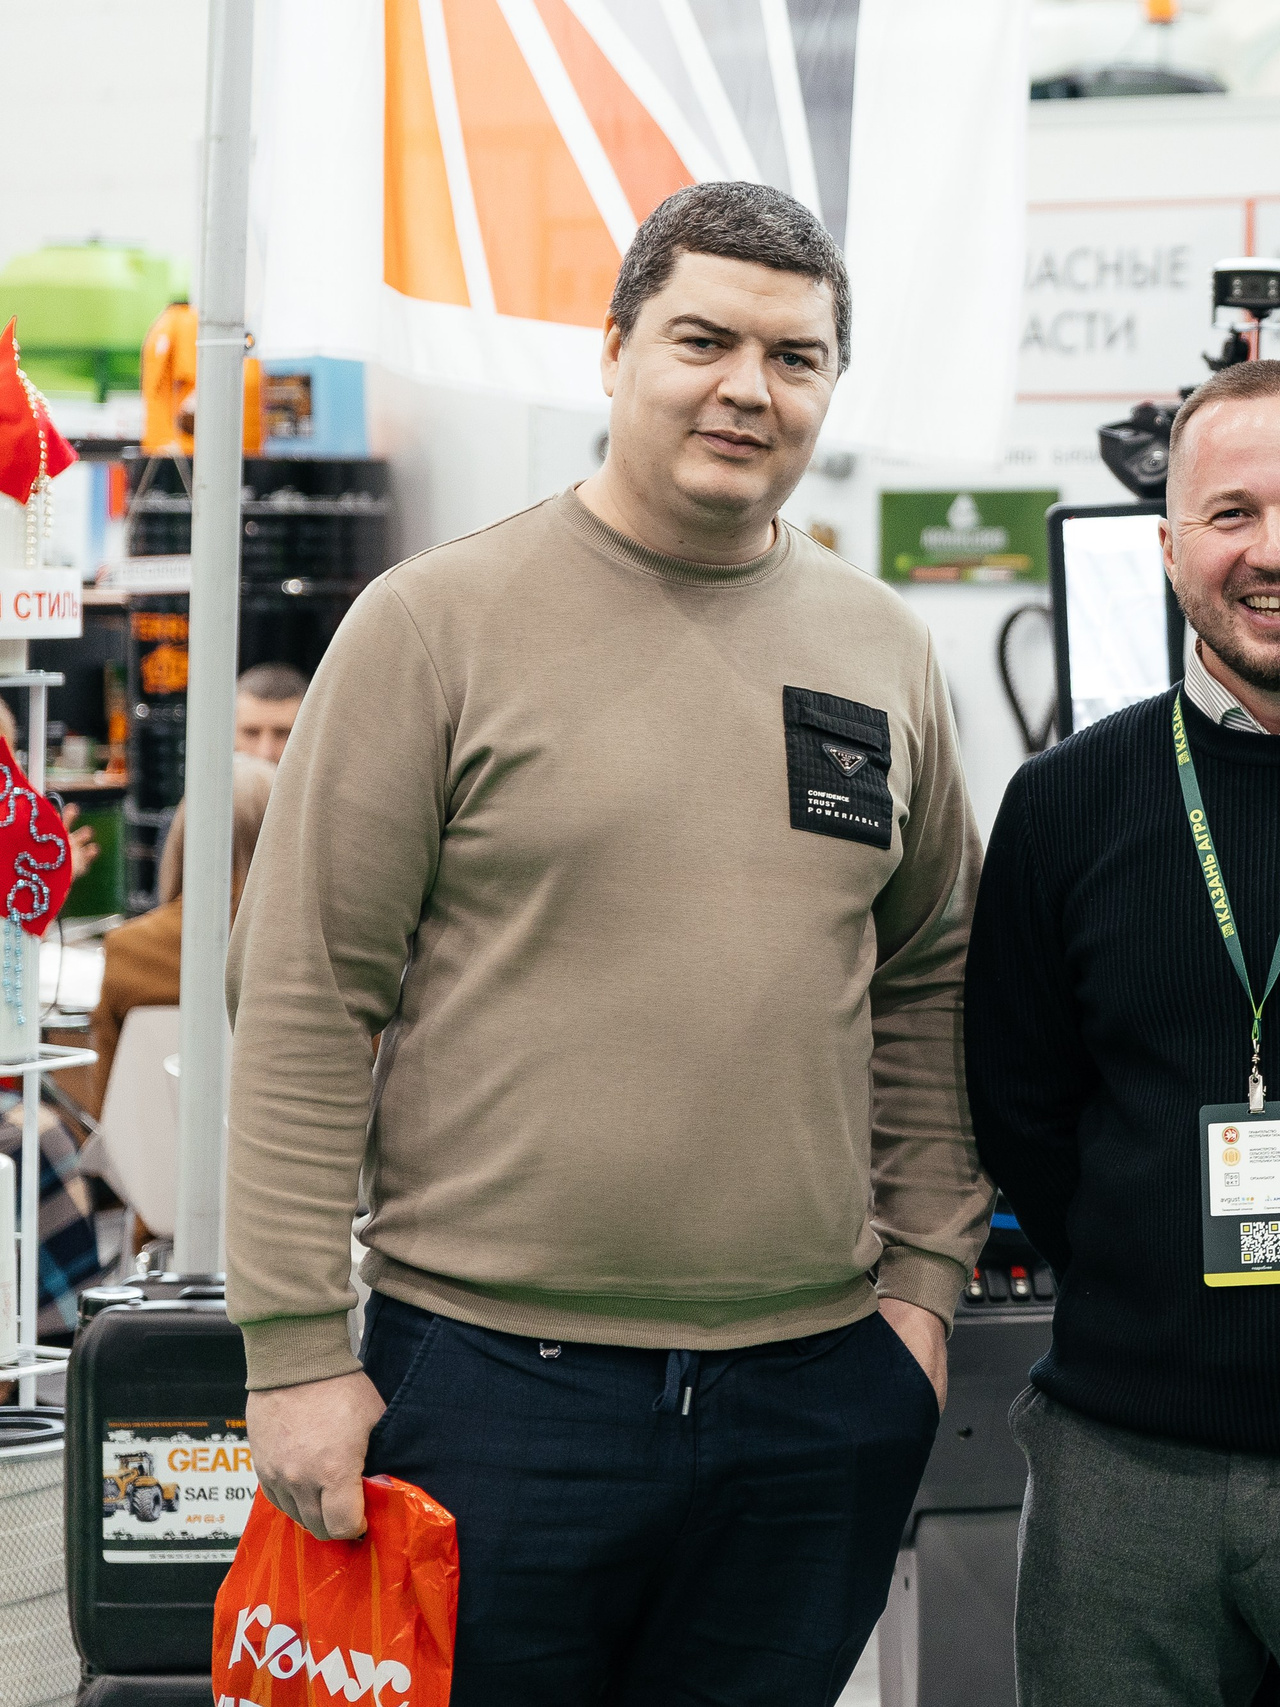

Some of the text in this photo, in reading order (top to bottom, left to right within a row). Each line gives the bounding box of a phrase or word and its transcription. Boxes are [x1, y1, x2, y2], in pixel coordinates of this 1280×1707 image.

[1019, 310, 1139, 354] АСТИ
[1172, 700, 1187, 753] КАЗА
[807, 789, 850, 803] CONFIDENCE
[807, 798, 836, 808] TRUST
[1188, 808, 1231, 925] КАЗАНЬ АГРО
[1220, 1196, 1240, 1204] avgust
[167, 1447, 253, 1473] GEAR
[184, 1487, 219, 1501] SAE
[185, 1514, 203, 1525] API
